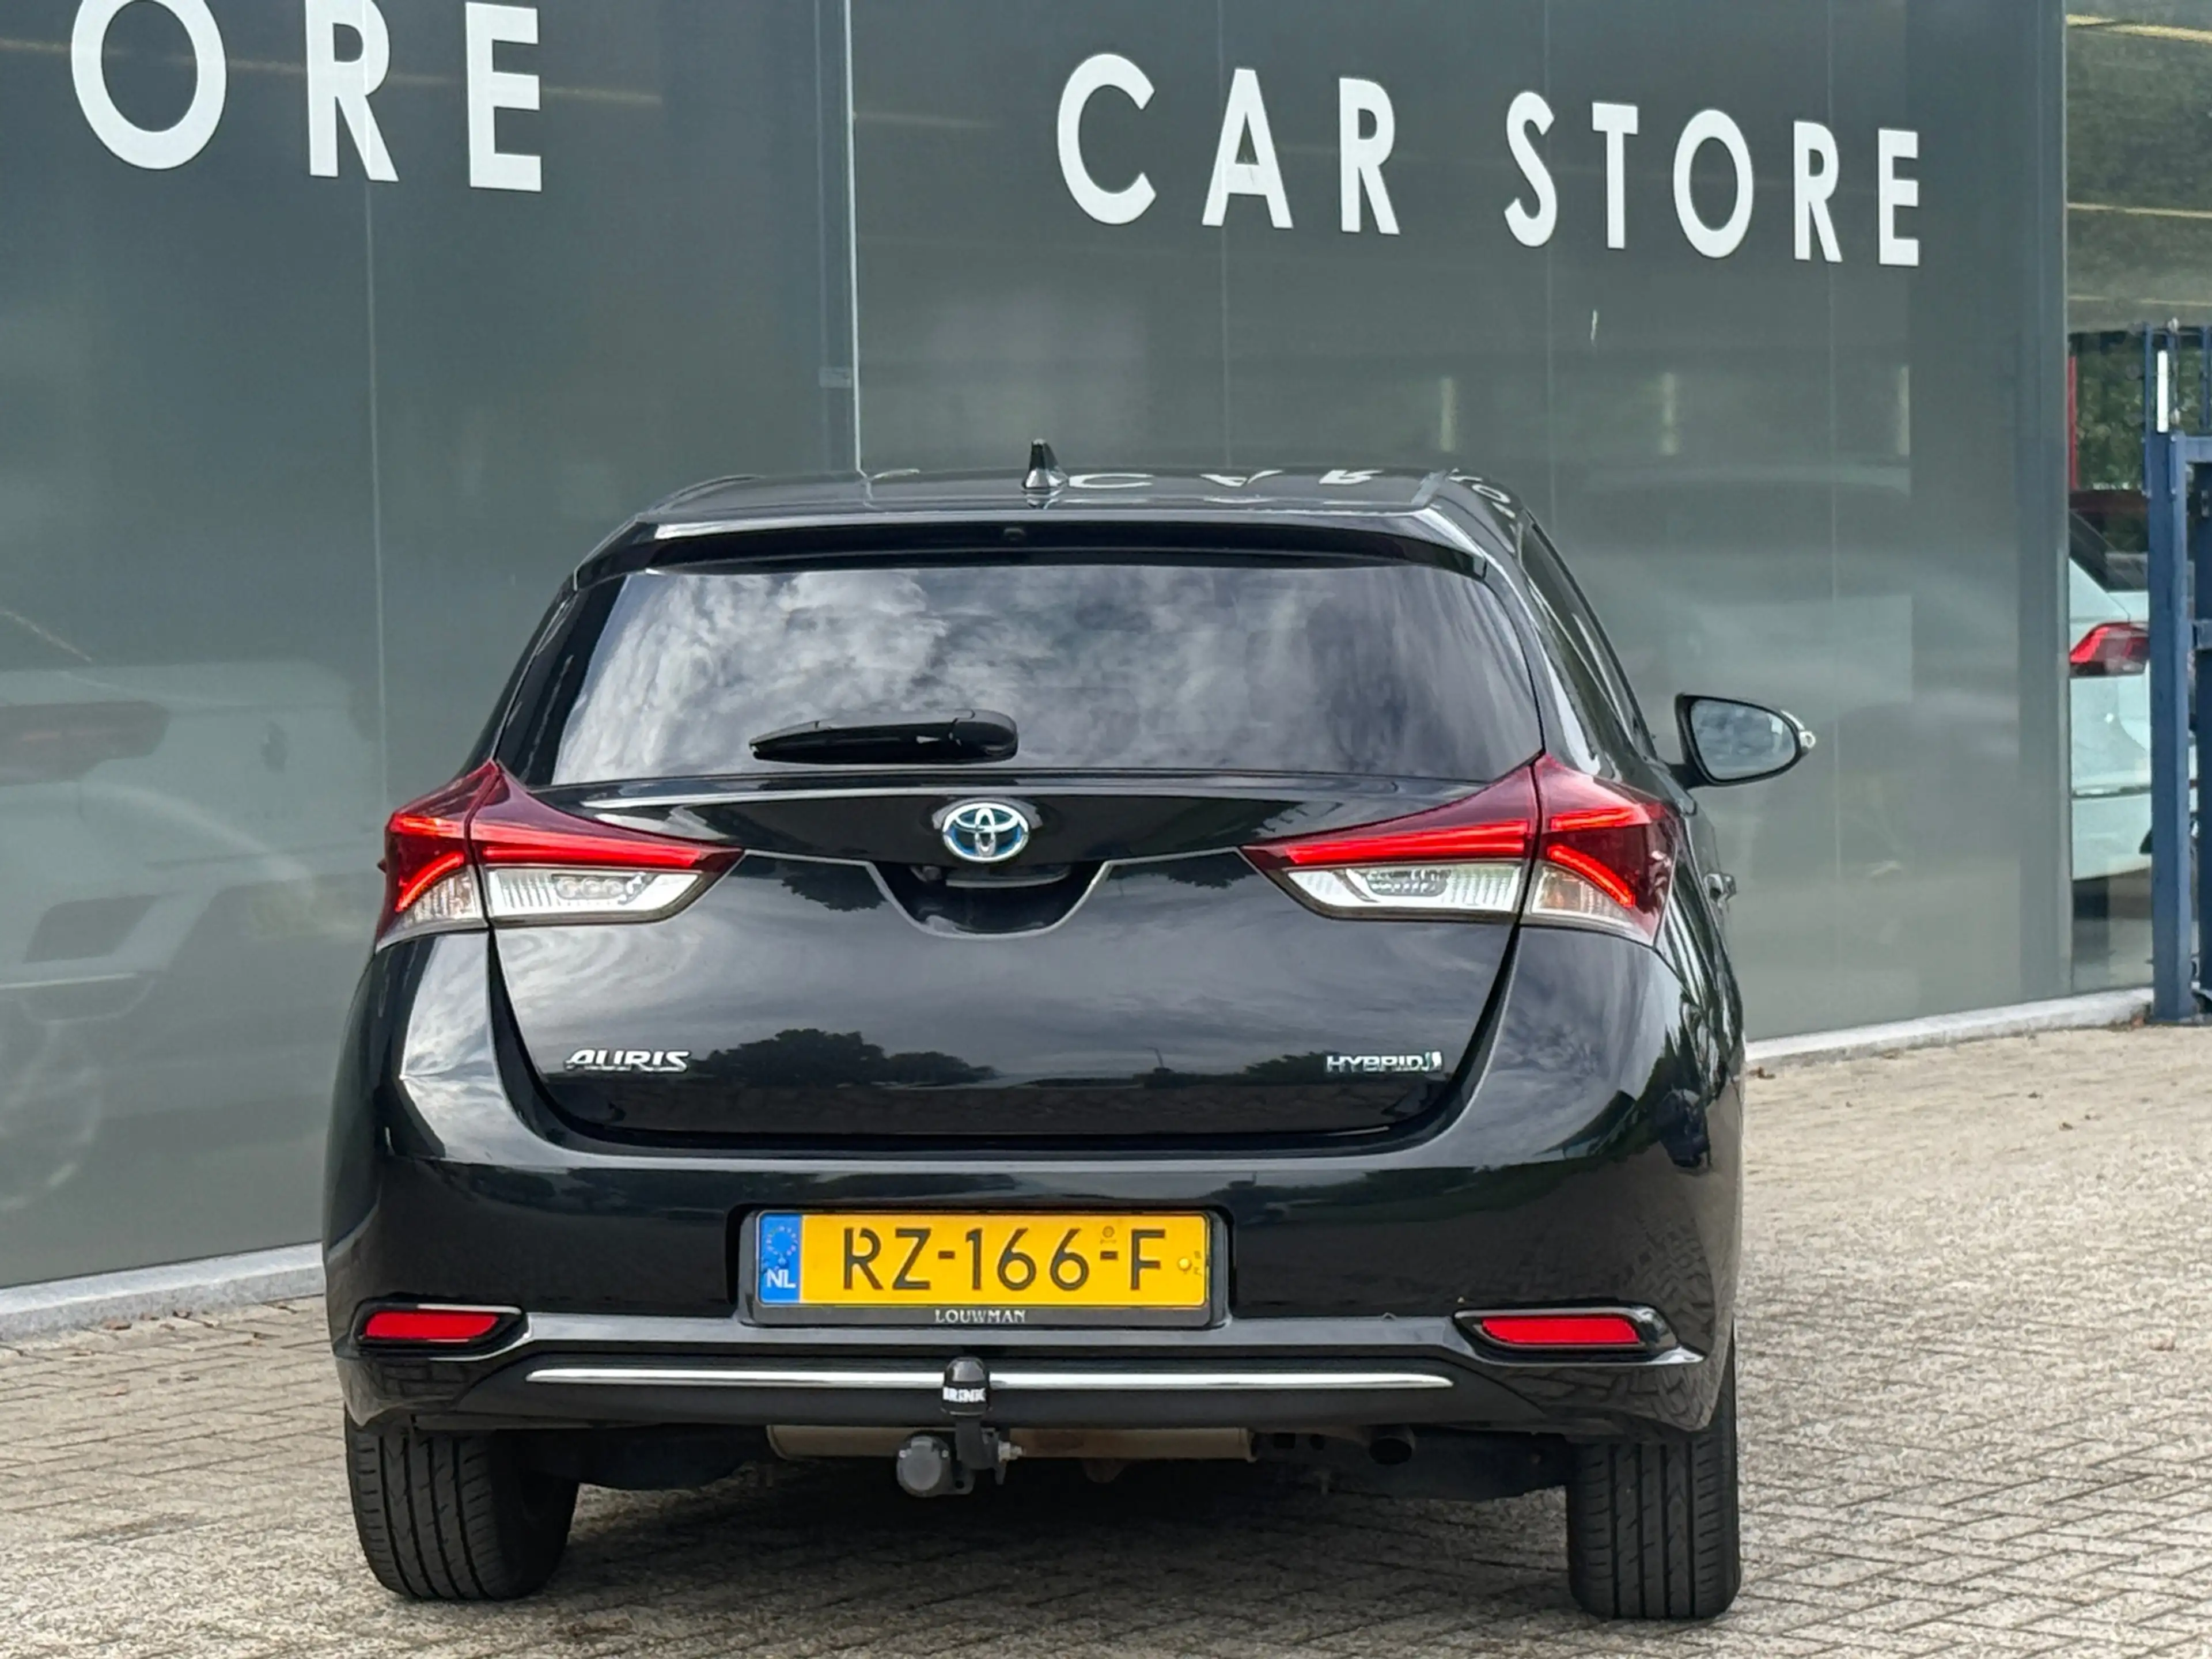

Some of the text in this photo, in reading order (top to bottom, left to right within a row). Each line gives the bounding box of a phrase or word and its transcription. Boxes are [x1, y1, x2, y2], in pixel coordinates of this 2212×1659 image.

[71, 0, 542, 191] ORE
[1057, 54, 1919, 267] CAR STORE
[565, 1049, 690, 1072] AURIS
[1327, 1055, 1423, 1073] HYBRID
[843, 1228, 1166, 1291] RZ-166-F
[767, 1269, 796, 1288] NL
[934, 1309, 1026, 1324] LOUWMAN
